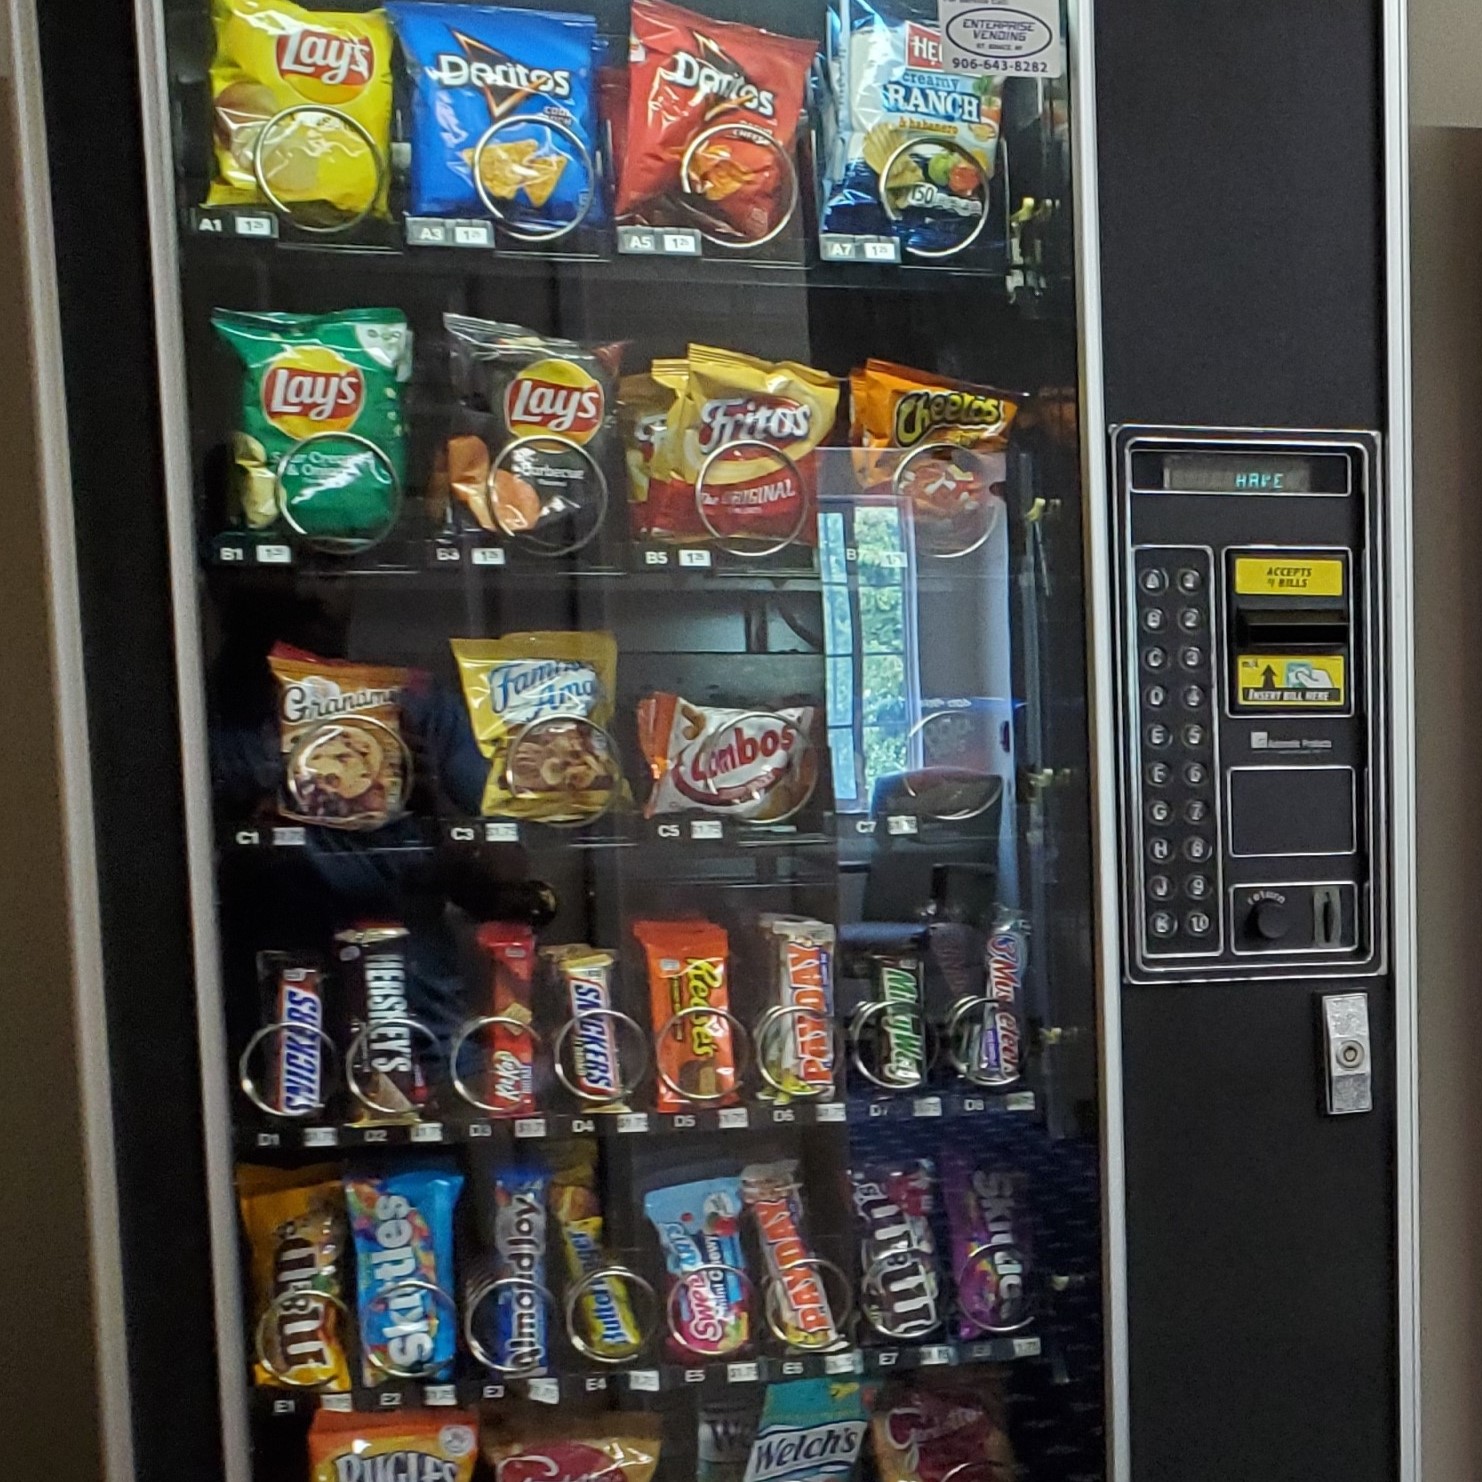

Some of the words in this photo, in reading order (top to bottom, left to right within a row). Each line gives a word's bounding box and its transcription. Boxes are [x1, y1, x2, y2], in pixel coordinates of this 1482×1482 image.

[963, 19, 1036, 32] ENTERPRISE
[974, 30, 1027, 41] VENDING
[281, 29, 370, 84] Lay's
[952, 58, 1048, 73] 906-643-8282
[438, 54, 571, 97] Doritos
[902, 71, 960, 91] creamy
[673, 51, 775, 117] Doritos
[886, 83, 981, 122] RANCH
[199, 218, 223, 232] A1
[421, 228, 442, 240] A3
[629, 236, 652, 248] A5
[832, 243, 852, 256] A7
[271, 368, 360, 420] Lay's
[512, 380, 600, 431] Lay's
[701, 398, 811, 454] Fritos
[896, 390, 1001, 448] Cheetos
[1235, 473, 1284, 489] HAVE
[220, 548, 243, 560] B1
[645, 551, 668, 564] B5
[1267, 567, 1313, 577] ACCEPTS
[1146, 573, 1160, 589] A
[1278, 578, 1308, 588] BILLS
[1147, 611, 1161, 628] B
[1148, 650, 1162, 667] C
[1249, 689, 1281, 700] INSERT
[283, 686, 398, 722] Grandm
[1151, 730, 1164, 745] E
[1153, 805, 1167, 821] G
[658, 824, 680, 837] C5
[856, 820, 877, 833] C7
[236, 831, 259, 844] C1
[451, 828, 474, 841] C3
[1154, 843, 1168, 858] H
[1156, 880, 1168, 896] J
[1247, 890, 1286, 905] return
[1156, 917, 1169, 933] K
[364, 954, 411, 1073] HERSHEY'S
[788, 943, 832, 1083] PAYDAY
[989, 955, 1021, 1077] Museteers
[574, 984, 612, 1088] SNICKERS
[283, 988, 321, 1113] SNICKERS
[674, 1115, 696, 1127] D5
[773, 1109, 795, 1122] D6
[572, 1120, 595, 1133] D4
[755, 1199, 831, 1333] PAYDAY
[879, 1352, 899, 1366] E7
[585, 1378, 607, 1391] E4
[754, 1427, 859, 1475] Welch's
